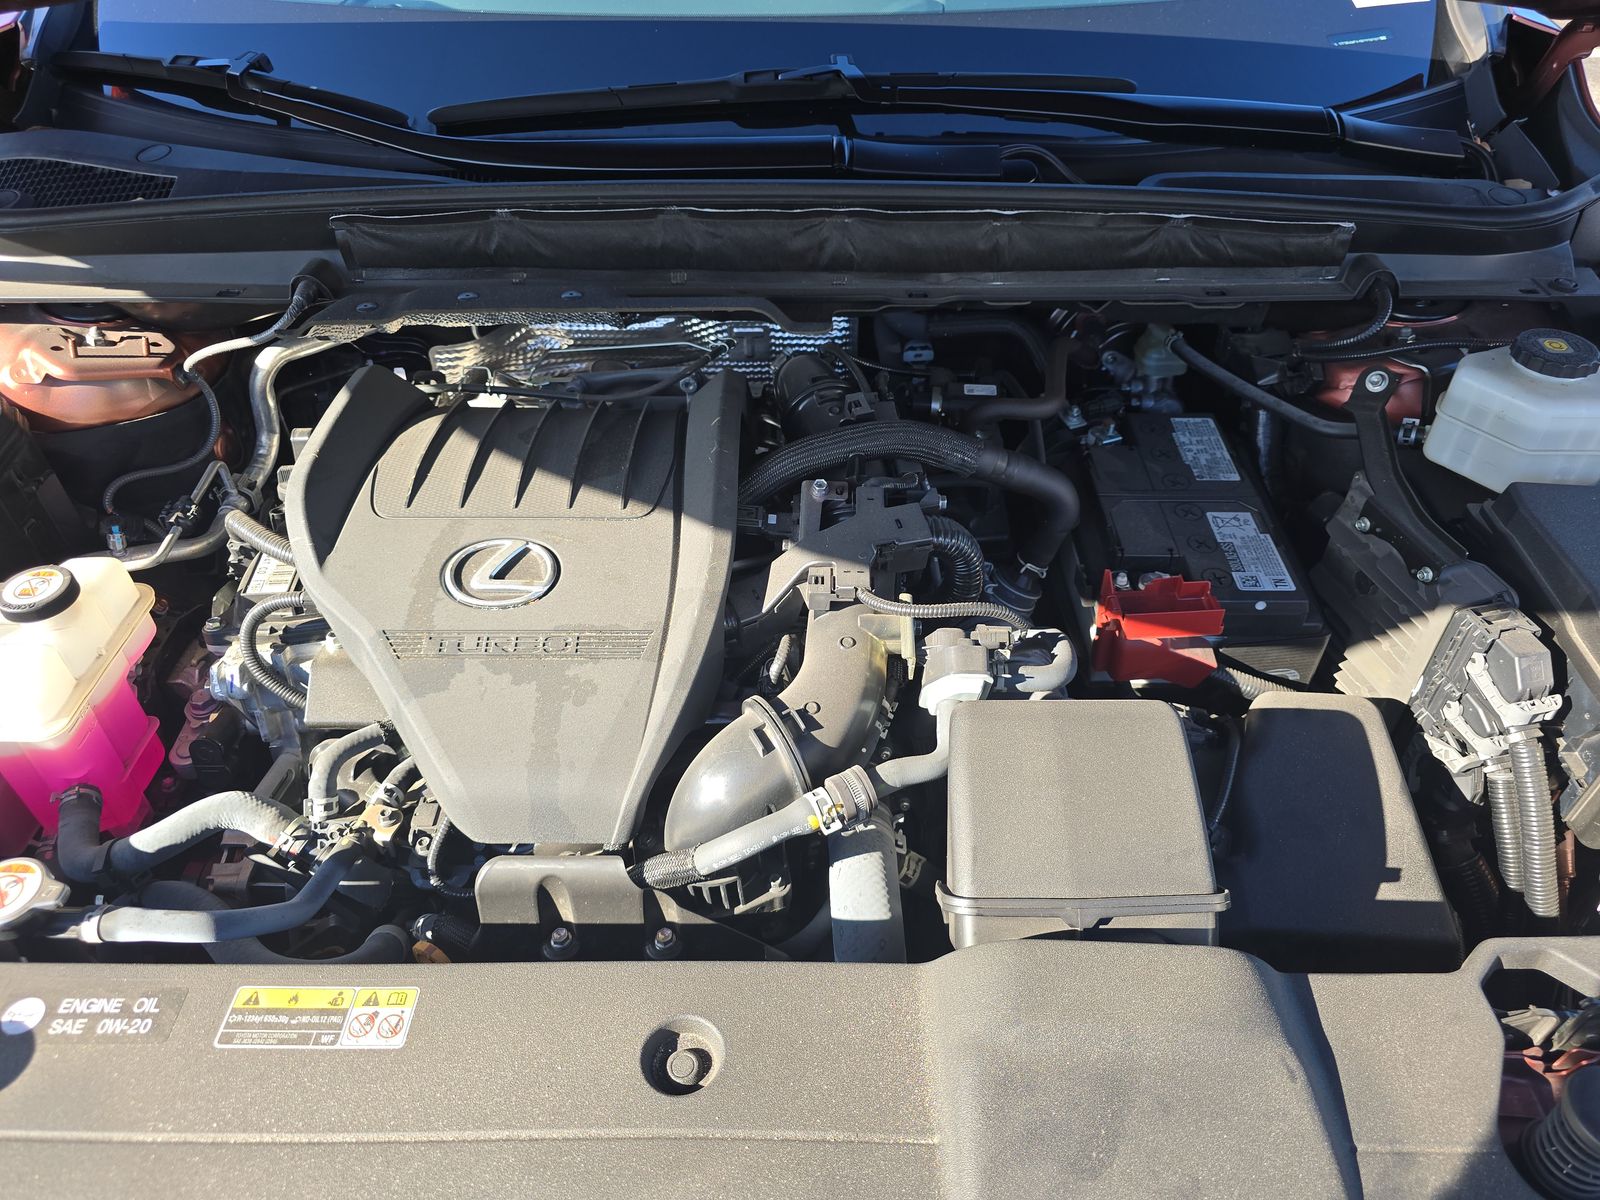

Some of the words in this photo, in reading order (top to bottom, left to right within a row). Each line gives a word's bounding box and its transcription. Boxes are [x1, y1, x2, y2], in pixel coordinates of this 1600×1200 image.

[57, 997, 125, 1014] ENGINE
[133, 997, 160, 1013] OIL
[48, 1018, 88, 1035] SAE
[96, 1018, 152, 1035] 0W-20
[320, 1034, 335, 1044] WF
